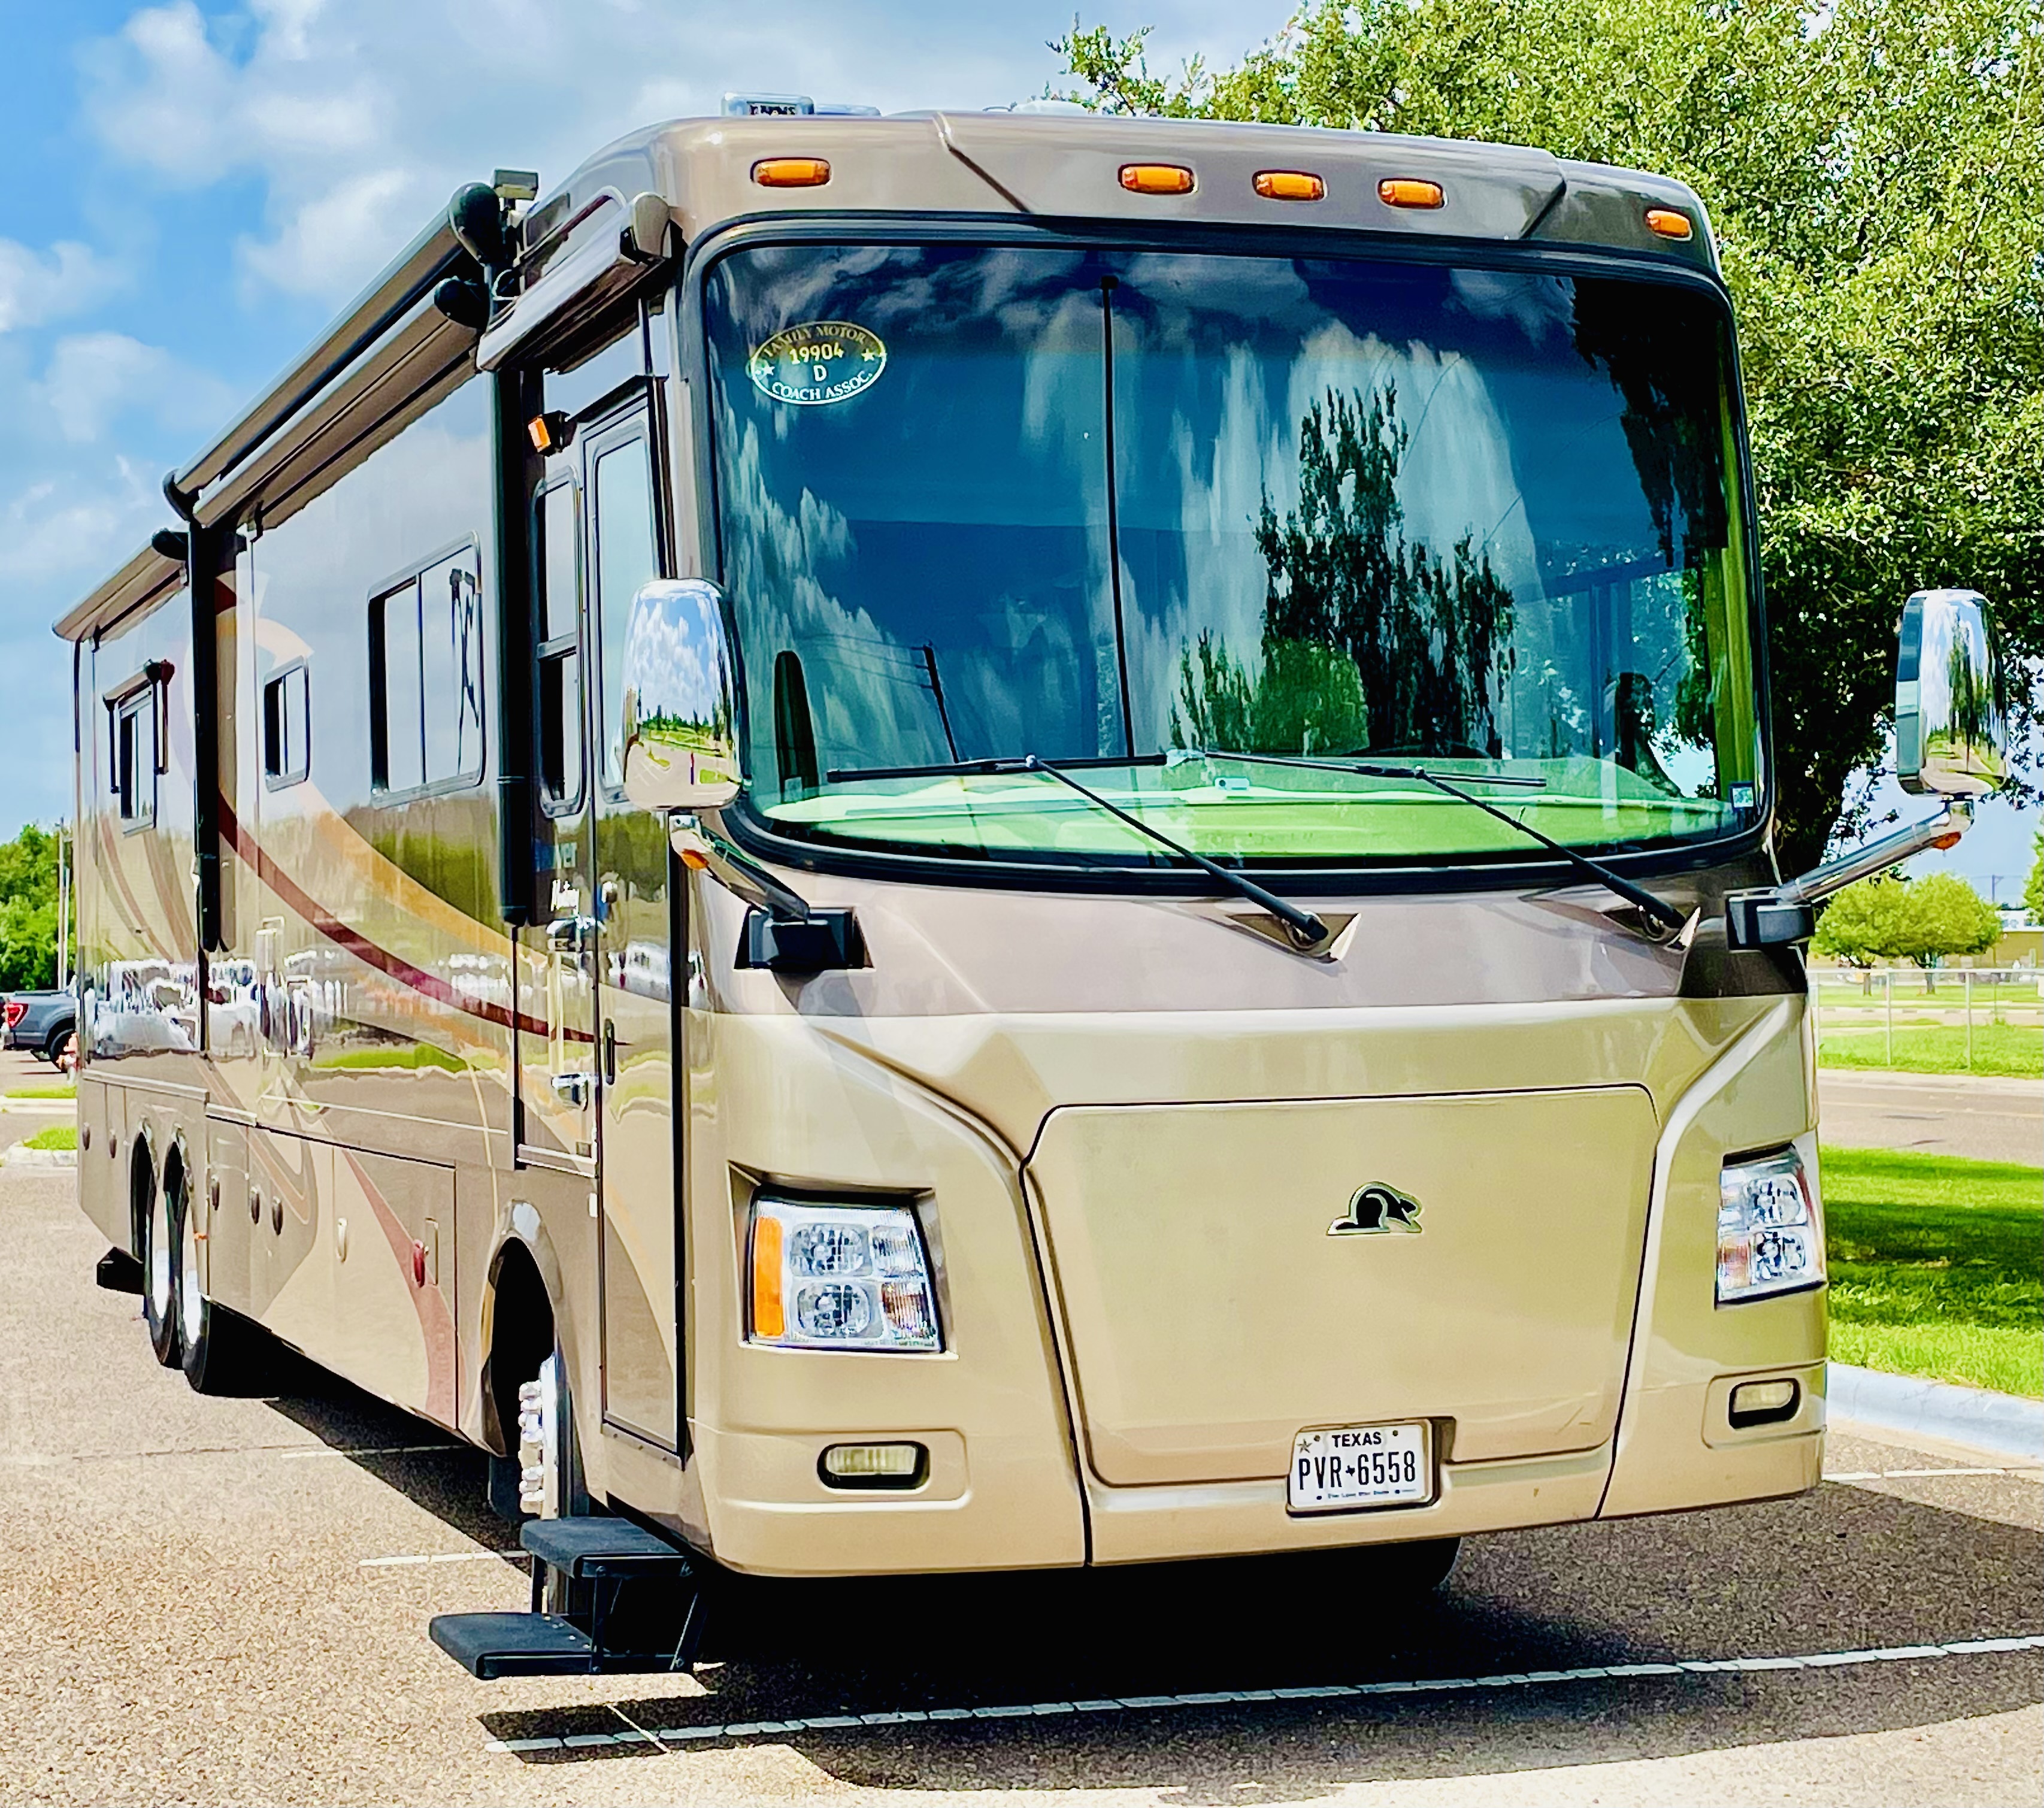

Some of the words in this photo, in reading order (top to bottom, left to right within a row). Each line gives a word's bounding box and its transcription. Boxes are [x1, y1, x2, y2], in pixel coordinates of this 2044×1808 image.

[816, 325, 867, 344] MOTOR
[789, 342, 844, 365] 19904
[813, 365, 827, 381] D
[772, 381, 821, 401] COACH
[825, 370, 873, 399] ASSOC.
[1331, 1431, 1382, 1448] TEXAS
